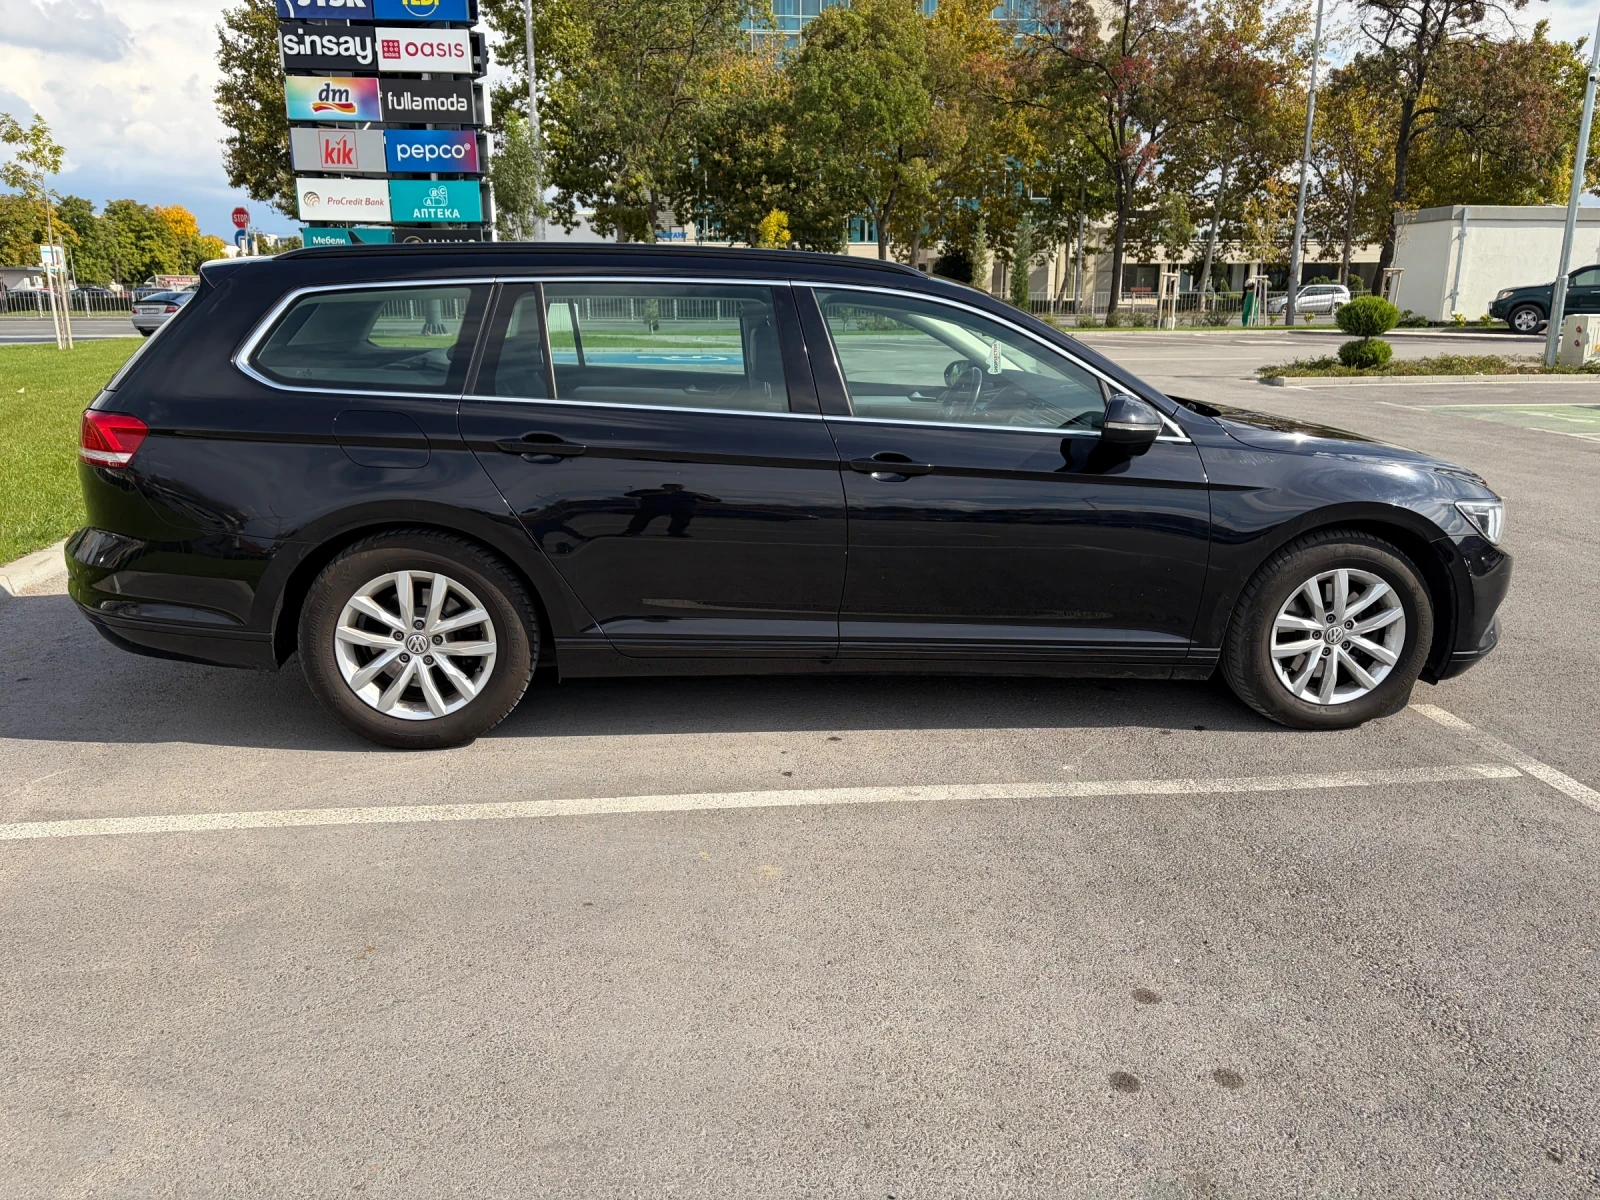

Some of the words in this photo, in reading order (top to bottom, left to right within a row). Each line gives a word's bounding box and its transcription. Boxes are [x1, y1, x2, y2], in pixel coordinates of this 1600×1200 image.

[283, 28, 372, 65] sinsay
[318, 83, 349, 102] dm
[388, 92, 467, 111] fullamoda
[327, 196, 363, 206] ProCredit
[365, 197, 384, 206] Bank
[233, 214, 248, 222] STOP
[413, 208, 460, 218] АПТЕКА
[312, 236, 346, 245] Мебели
